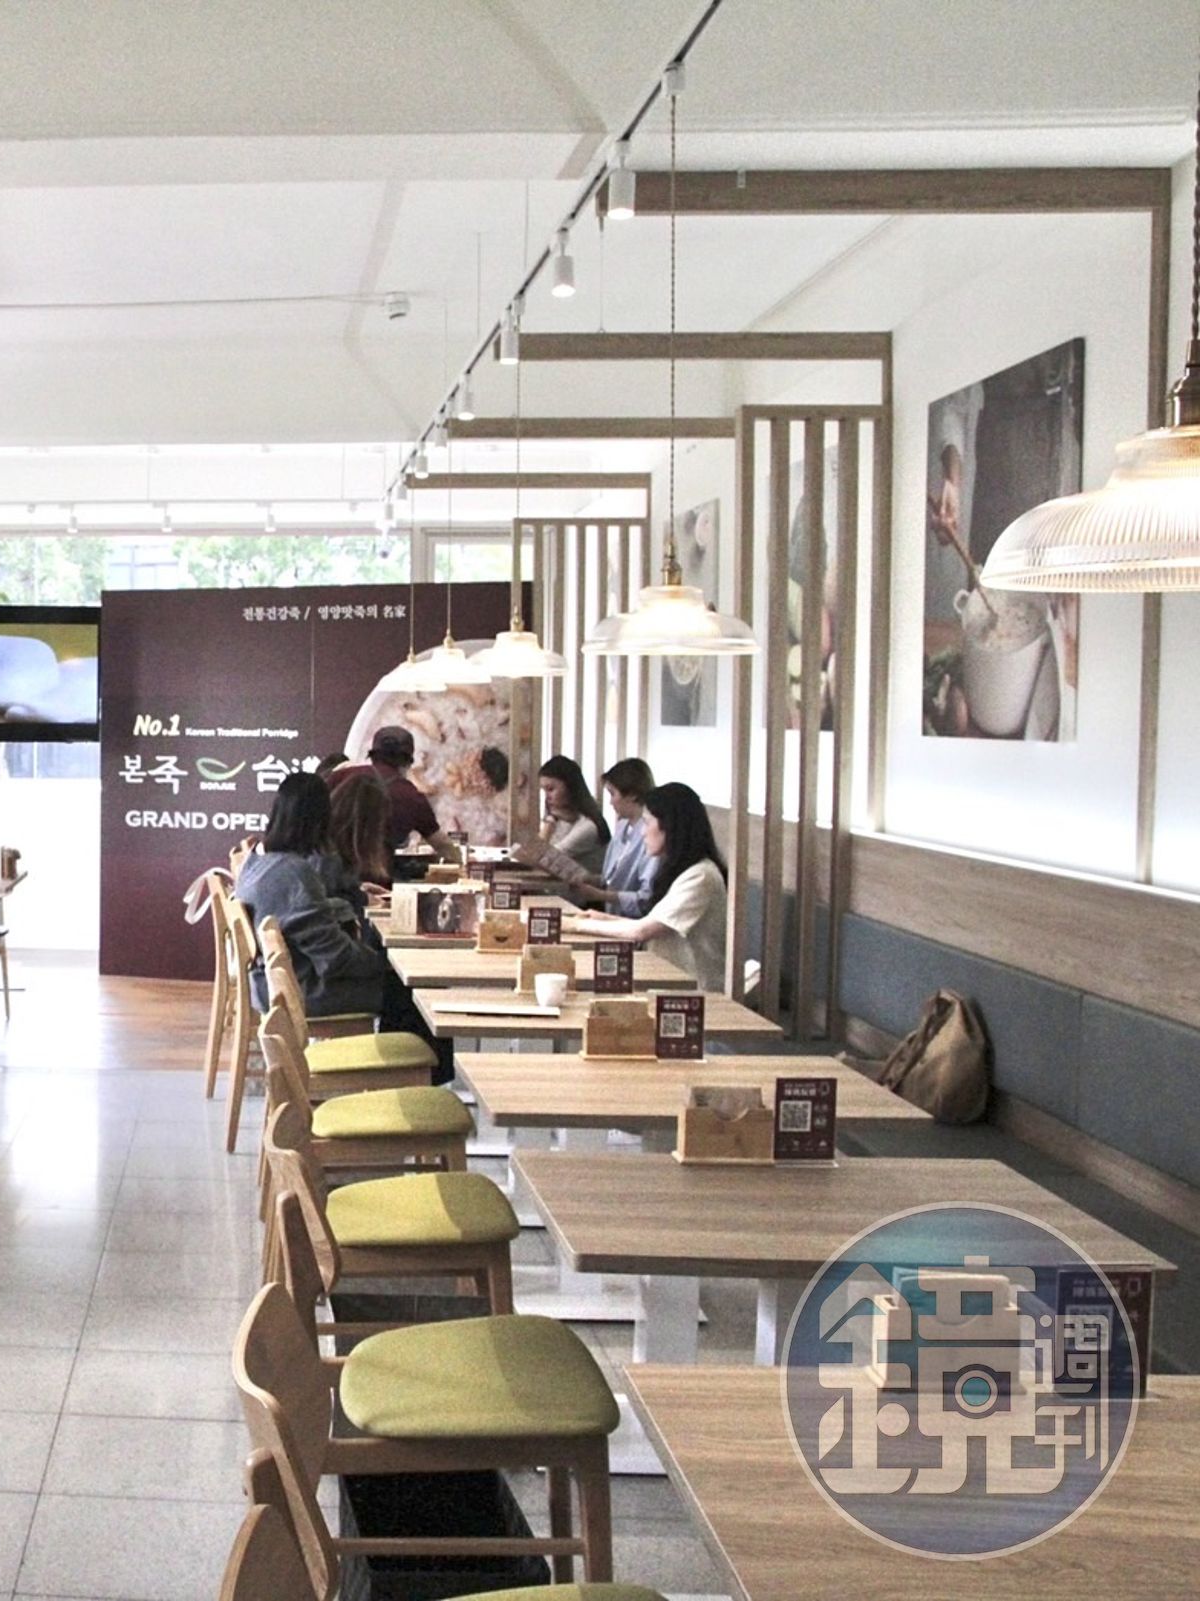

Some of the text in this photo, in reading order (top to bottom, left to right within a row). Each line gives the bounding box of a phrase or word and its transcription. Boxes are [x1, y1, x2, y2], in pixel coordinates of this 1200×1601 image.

[133, 714, 181, 736] No.1
[118, 754, 189, 795] 본죽
[125, 810, 208, 829] GRAND
